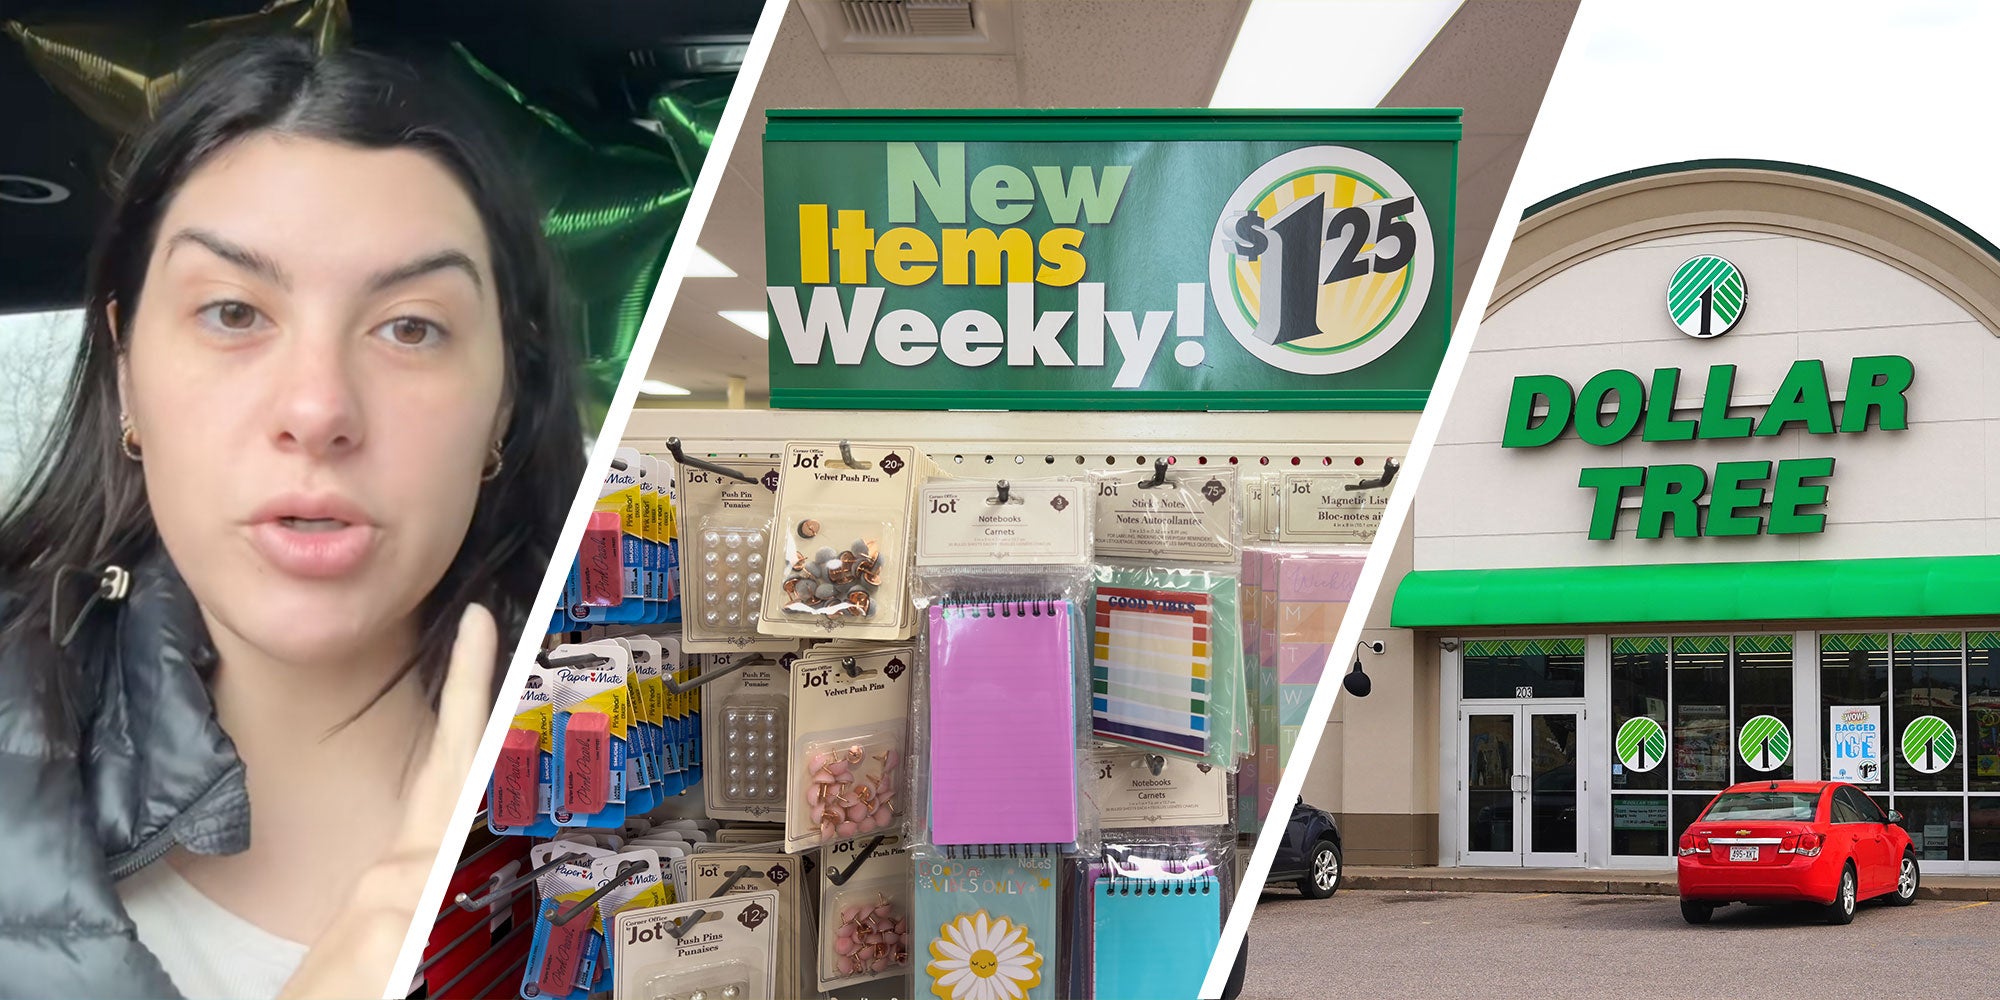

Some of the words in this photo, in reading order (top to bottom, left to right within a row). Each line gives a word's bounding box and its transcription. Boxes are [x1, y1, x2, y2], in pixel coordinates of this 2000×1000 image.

[886, 141, 1132, 224] New
[799, 203, 1086, 287] Items
[766, 282, 1206, 389] Weekly!
[1502, 354, 1915, 449] DOLLAR
[793, 454, 820, 468] Jot
[606, 474, 636, 484] Mate
[689, 472, 708, 483] Jot
[814, 473, 838, 481] Velvet
[840, 474, 860, 482] Push
[862, 474, 880, 482] Pins
[1207, 486, 1219, 496] 75
[1292, 483, 1310, 494] Jot
[1162, 499, 1185, 508] Notes
[1322, 496, 1366, 506] Magnetic
[1577, 457, 1837, 541] TREE
[931, 499, 956, 514] Jot
[1116, 515, 1140, 524] Notes
[1141, 515, 1202, 526] Autocollantes
[1318, 512, 1370, 520] Bloc-notes
[1108, 596, 1148, 610] GOOD
[1150, 600, 1196, 613] VIBES
[1286, 606, 1300, 621] M
[714, 654, 730, 664] Jot
[1288, 648, 1298, 662] T
[558, 669, 590, 683] Paper
[595, 672, 622, 684] Mate
[803, 670, 828, 688] Jot
[522, 690, 550, 701] Mate
[824, 688, 848, 697] Velvet
[850, 686, 867, 694] Push
[869, 683, 885, 691] Pins
[1516, 687, 1532, 698] 203
[1284, 689, 1302, 705] W
[1845, 712, 1866, 721] WOW!
[1835, 732, 1876, 758] ICE
[1132, 778, 1171, 787] Notebooks
[1138, 792, 1166, 800] Carnets
[874, 850, 889, 858] Push
[555, 865, 582, 877] Paper
[700, 867, 718, 877] Jot
[634, 875, 658, 884] Mate
[932, 876, 978, 892] VIBES
[982, 879, 1026, 895] ONLY
[628, 923, 663, 945] Jot
[677, 936, 700, 946] Push
[702, 933, 723, 942] Pins
[678, 945, 719, 957] Punaises
